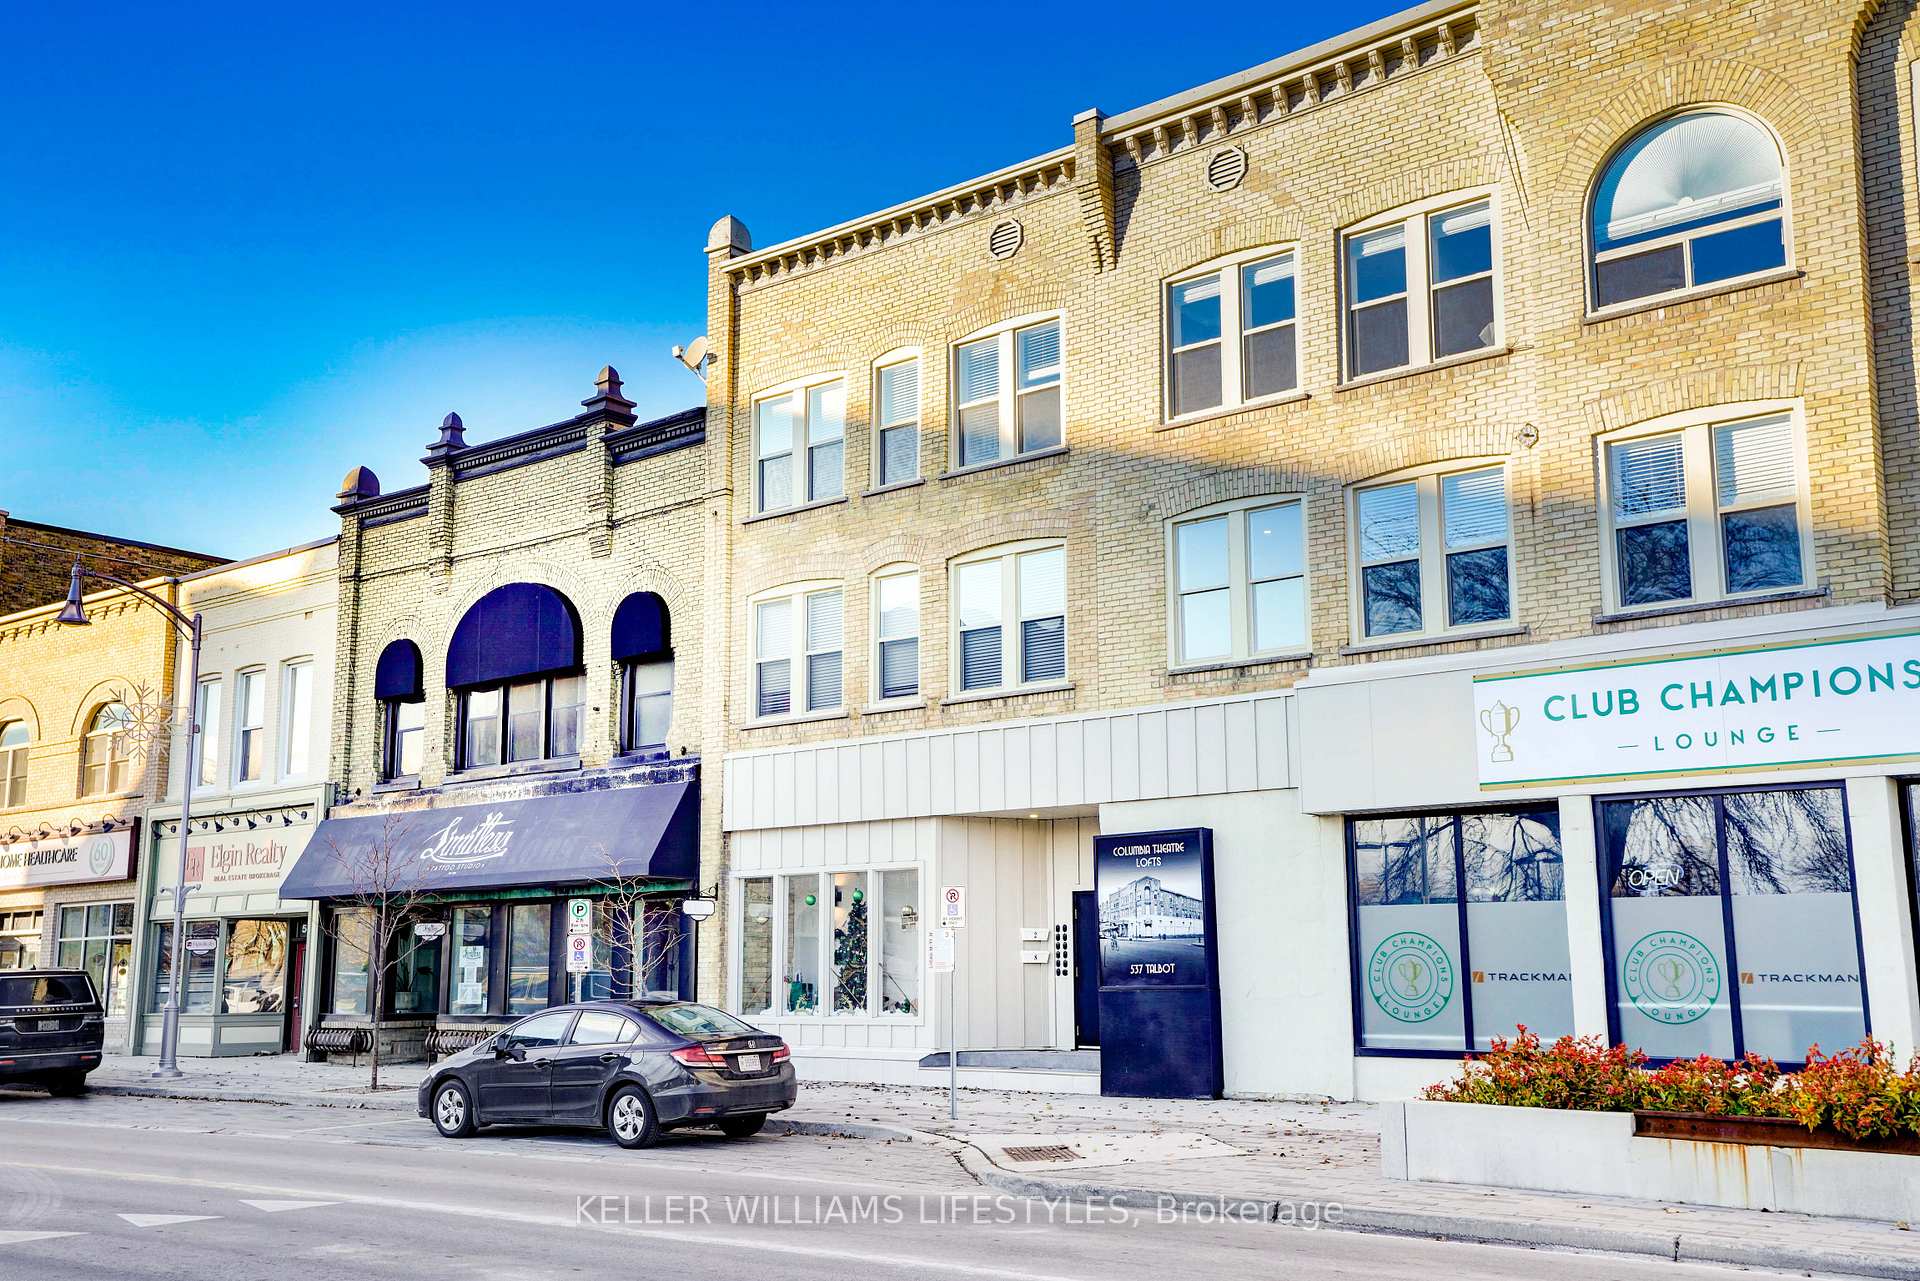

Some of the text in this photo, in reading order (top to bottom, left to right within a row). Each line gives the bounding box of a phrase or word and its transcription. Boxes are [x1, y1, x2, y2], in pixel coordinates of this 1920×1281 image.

[1543, 659, 1920, 722] CLUB CHAMPIONS
[1654, 724, 1800, 752] LOUNGE
[24, 847, 79, 867] HEALTHCARE
[211, 839, 288, 874] Elgin Realty
[1113, 842, 1185, 857] COLUMBIA THEATRE
[456, 862, 481, 870] STUDIO
[1136, 856, 1162, 868] LOFTS
[1629, 868, 1680, 887] OPEN
[1130, 963, 1176, 975] 537 TALBOT
[1373, 938, 1449, 983] CLUB CHAMPIONS
[1629, 937, 1715, 983] CLUB CHAMPIONS
[1488, 972, 1572, 982] TRACKMA
[1758, 973, 1859, 983] TRACKMAN
[1383, 1000, 1440, 1019] LOUNGE
[1641, 1000, 1706, 1020] OUNG
